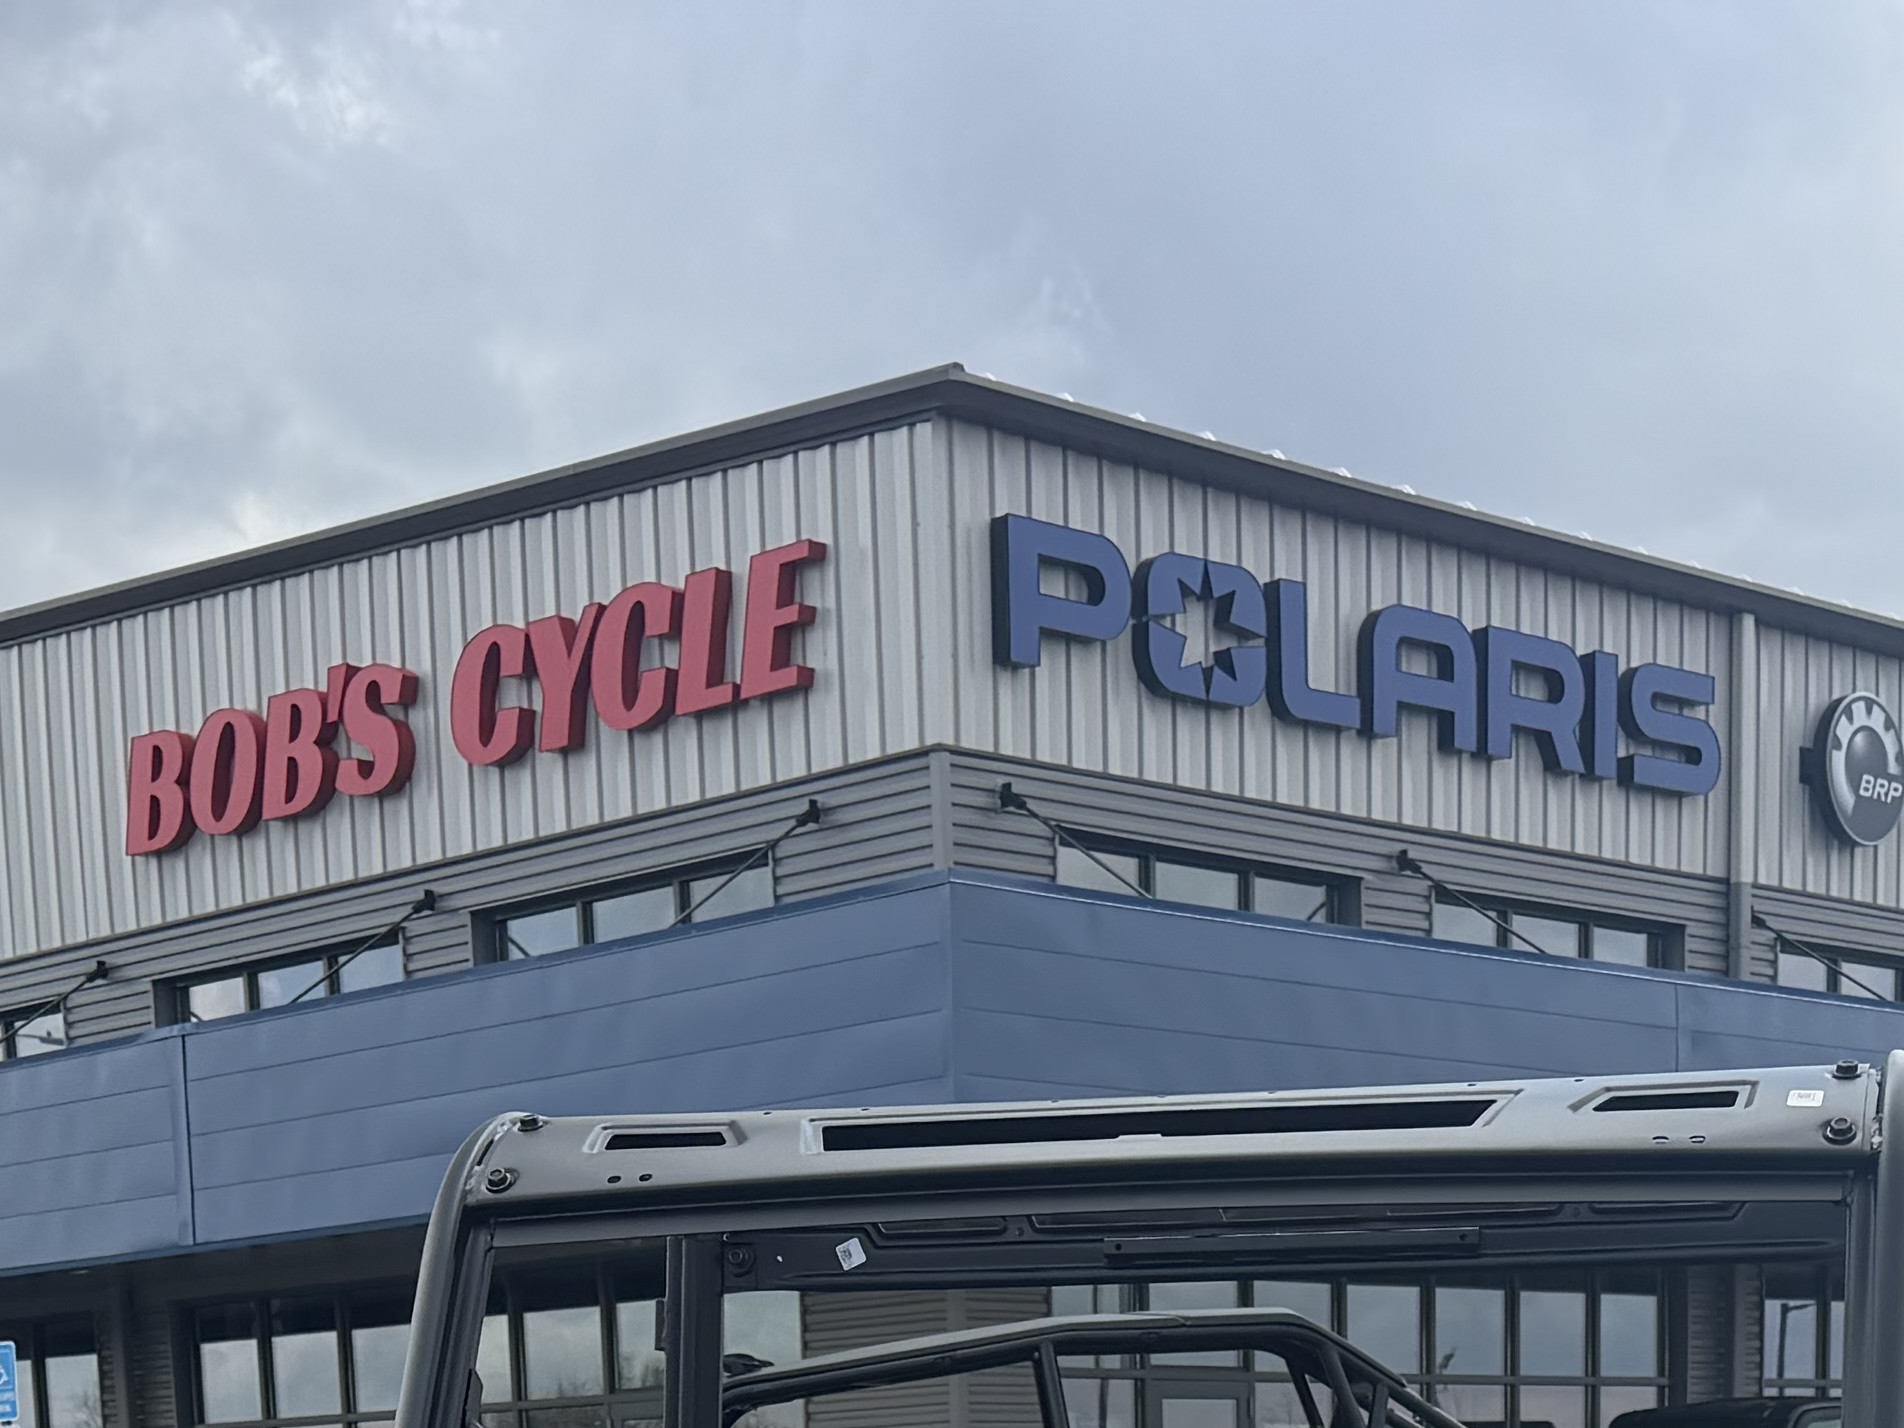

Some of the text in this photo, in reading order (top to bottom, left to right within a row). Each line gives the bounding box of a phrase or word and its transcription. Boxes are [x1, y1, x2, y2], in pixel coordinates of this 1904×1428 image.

[126, 538, 828, 857] BOB'S CYCLE
[991, 513, 1722, 797] POLARIS
[1859, 773, 1903, 804] BRP
